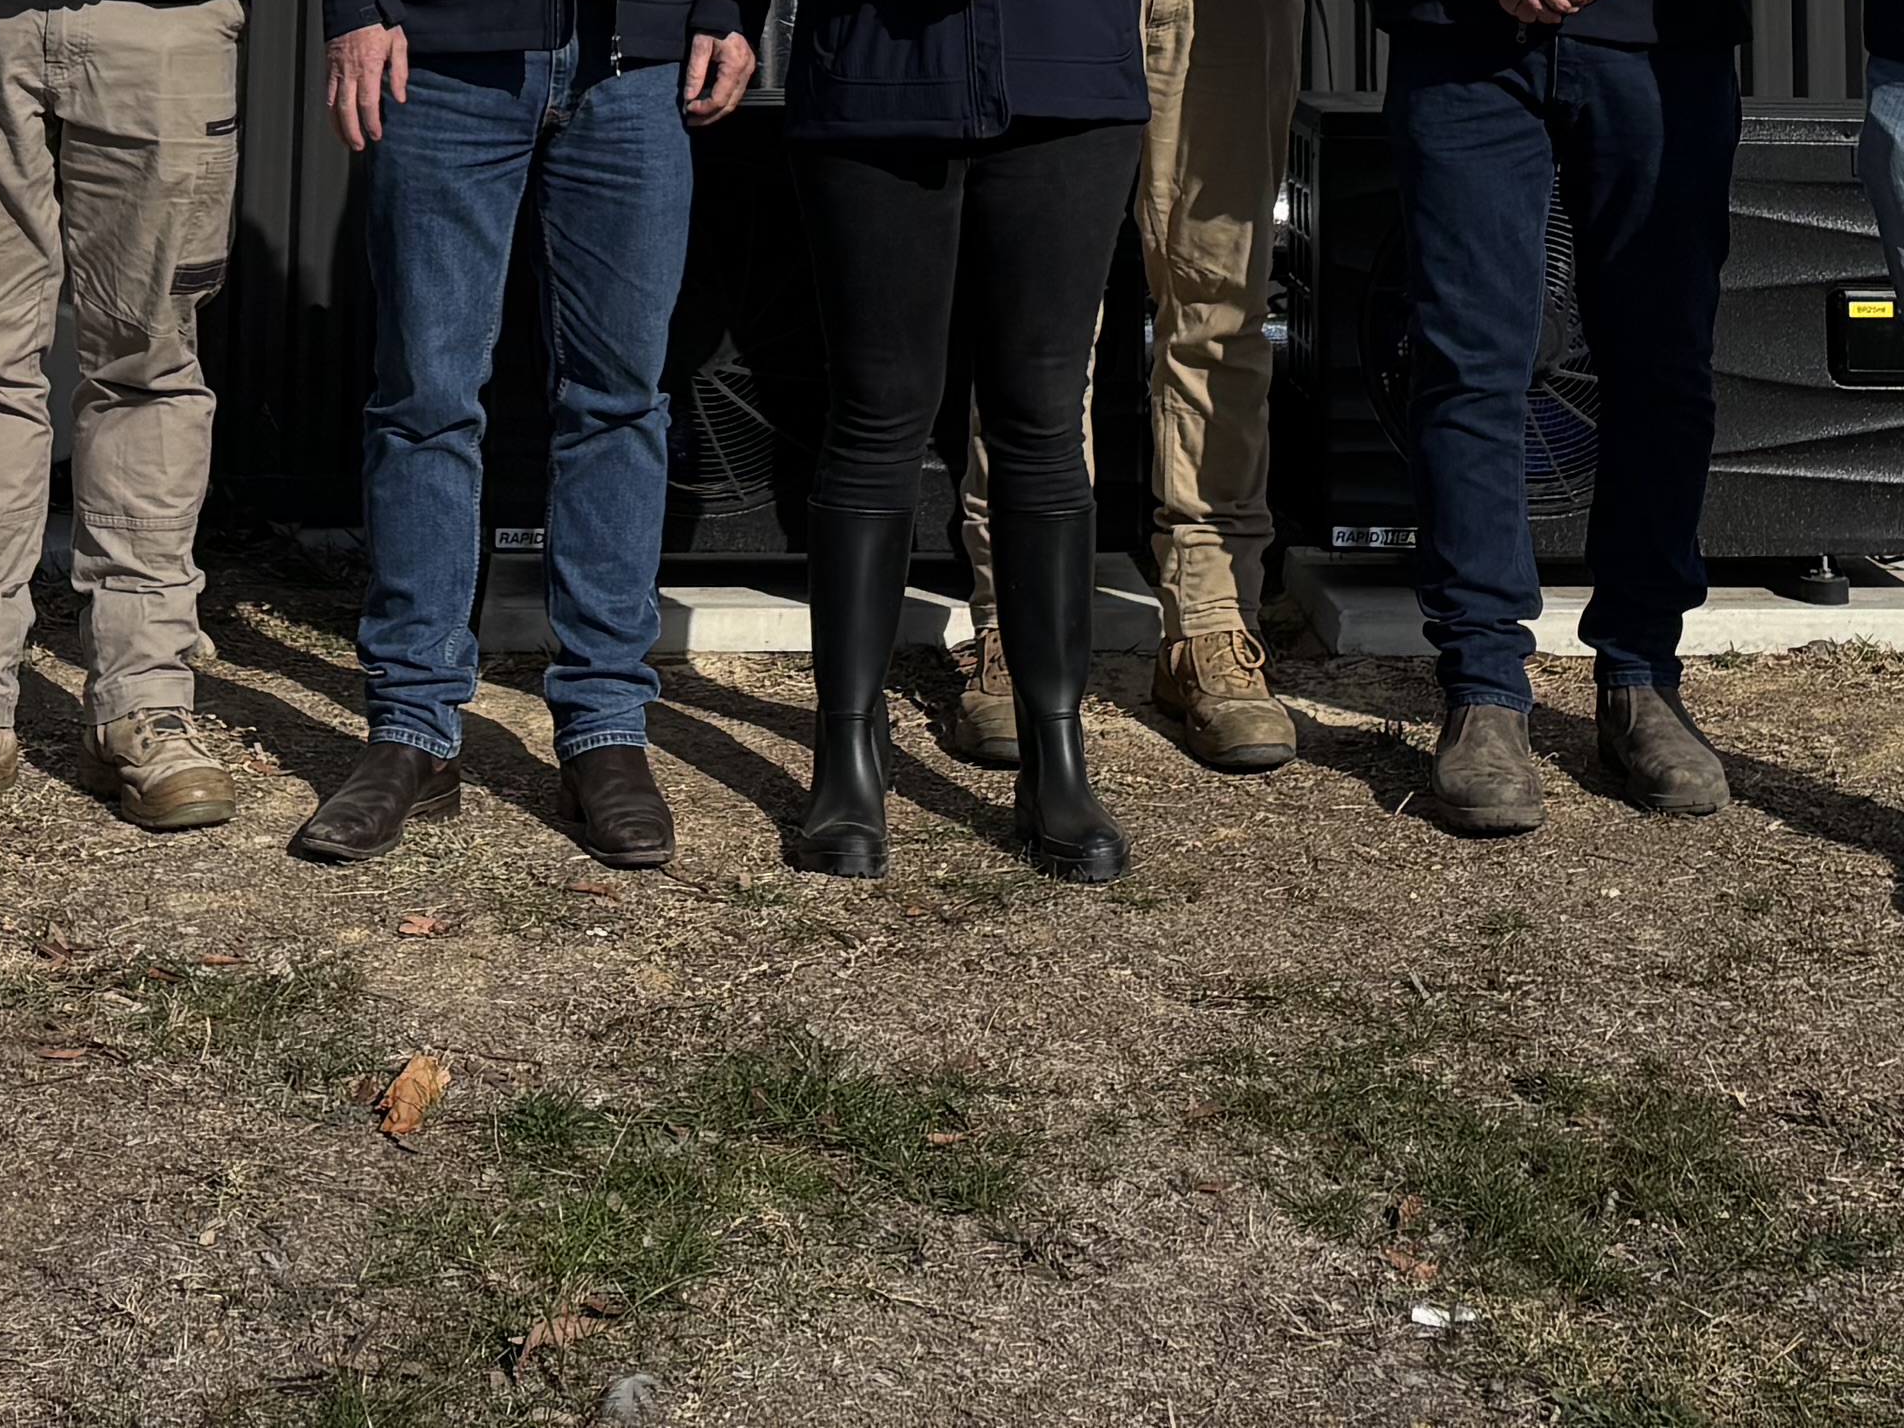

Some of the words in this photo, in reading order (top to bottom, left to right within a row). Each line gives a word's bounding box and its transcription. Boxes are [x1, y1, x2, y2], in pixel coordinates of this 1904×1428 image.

[500, 531, 544, 545] RAPID
[1335, 530, 1380, 544] RAPID
[1386, 531, 1417, 545] HEA
